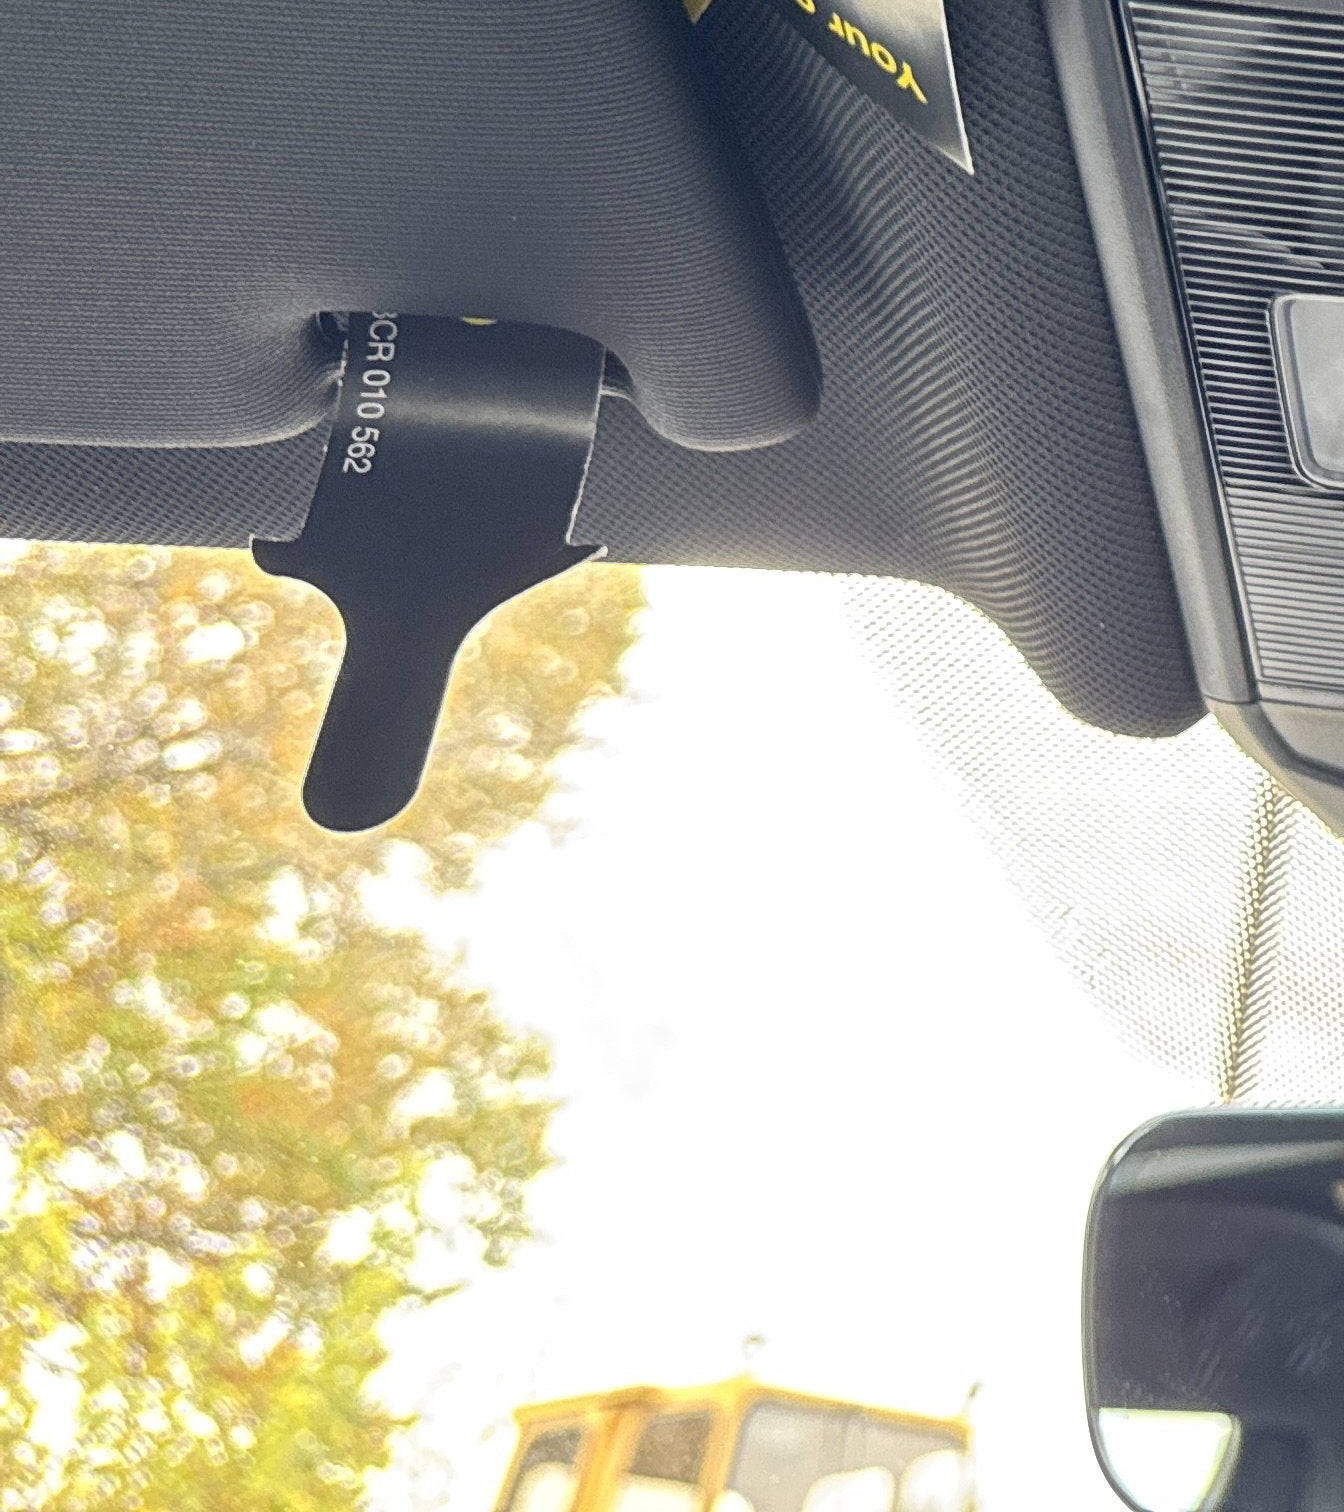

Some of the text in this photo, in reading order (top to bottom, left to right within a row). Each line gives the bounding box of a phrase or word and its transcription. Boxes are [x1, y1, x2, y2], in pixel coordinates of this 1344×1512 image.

[828, 12, 929, 105] Your
[356, 368, 392, 420] 010
[342, 425, 381, 475] 562
